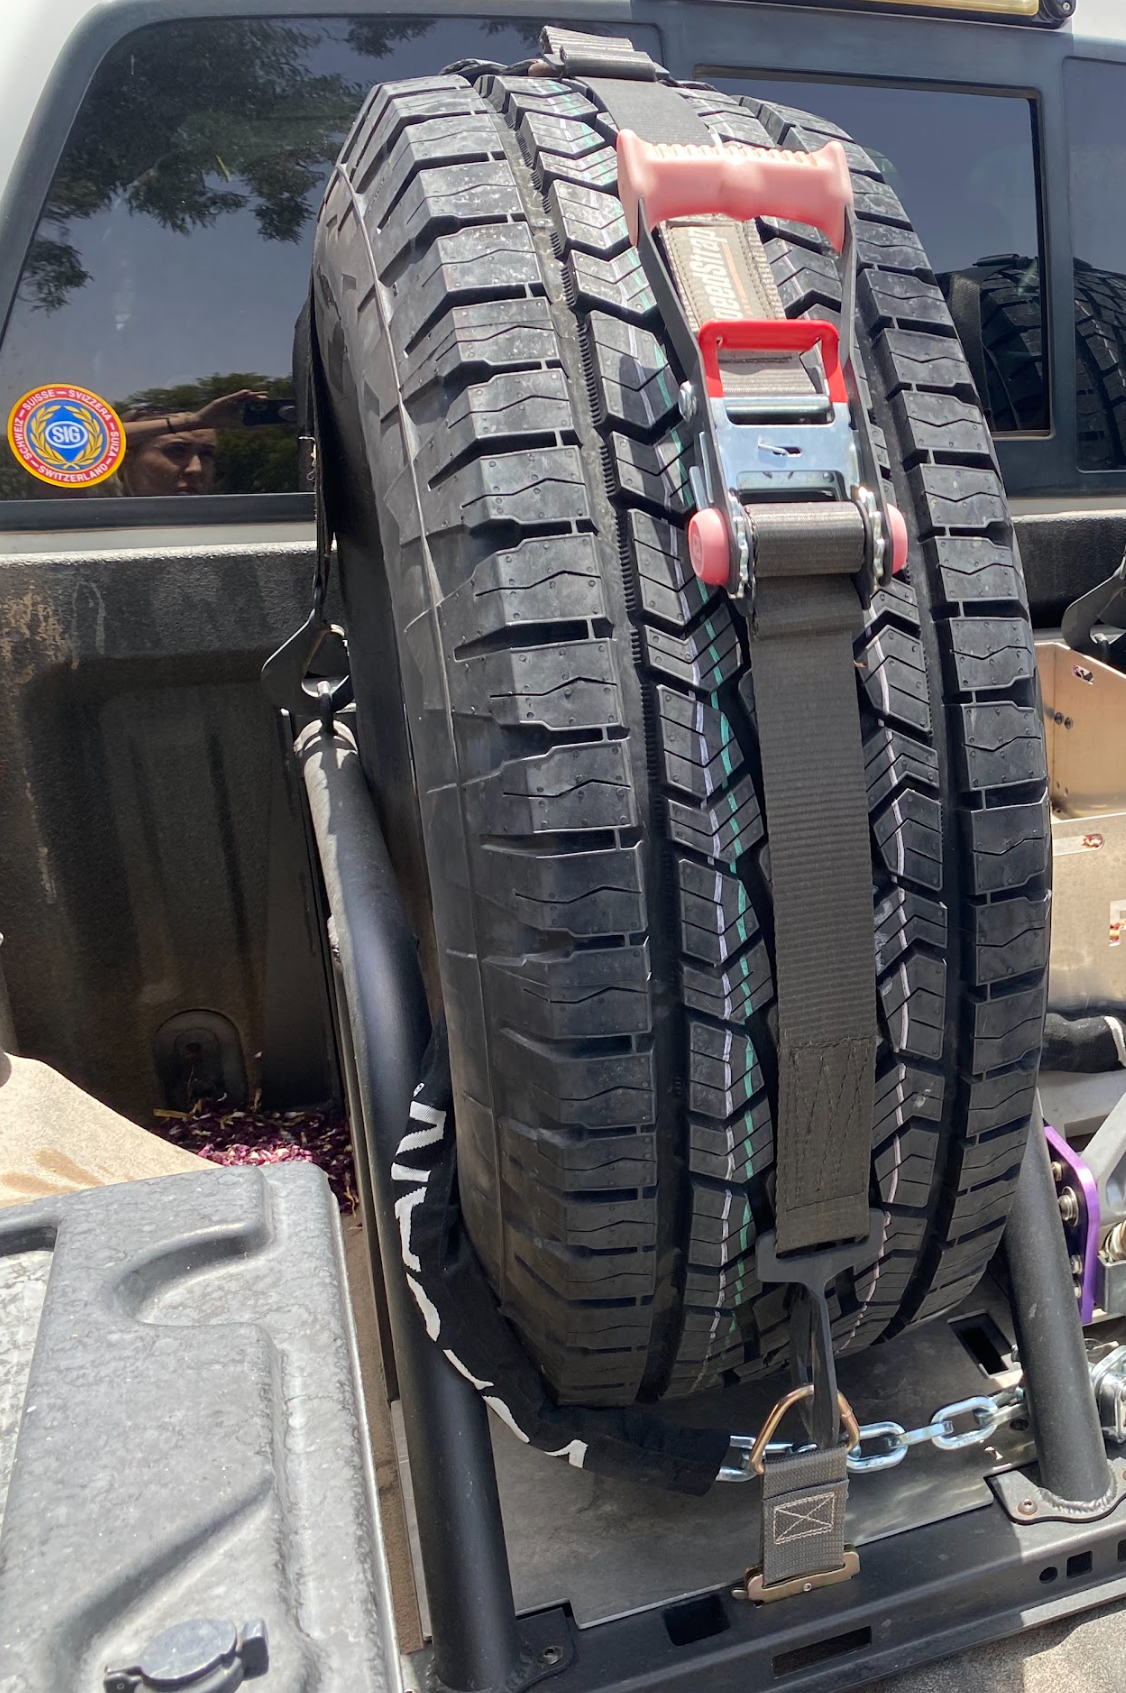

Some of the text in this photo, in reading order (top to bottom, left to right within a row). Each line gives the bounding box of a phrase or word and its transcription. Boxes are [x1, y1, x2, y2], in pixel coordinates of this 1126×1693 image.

[14, 389, 119, 460] SCHWEIZ SUISSE SVIZZERA SUIZA
[51, 426, 81, 443] SIG
[38, 463, 108, 482] SWITZERLAND
